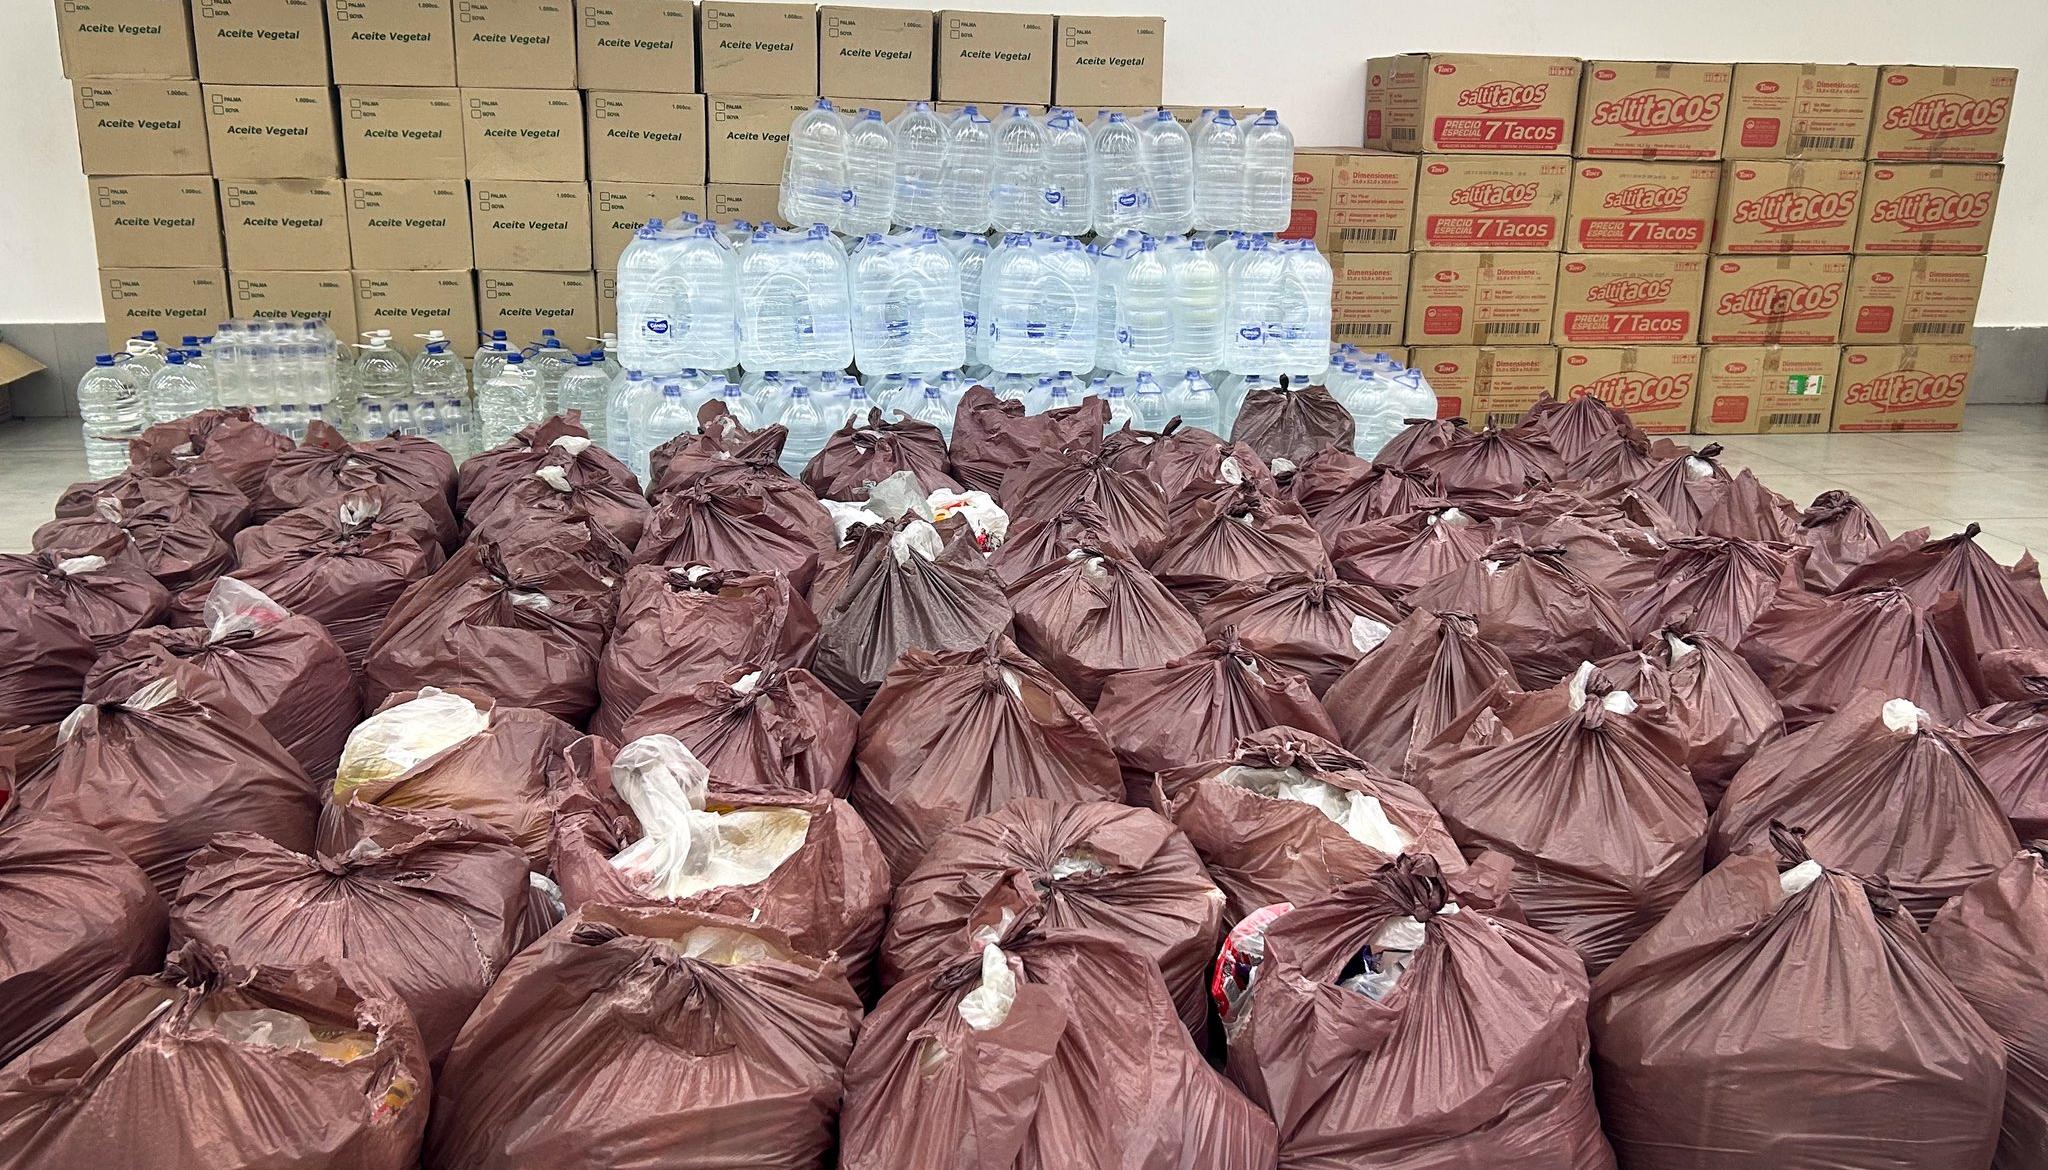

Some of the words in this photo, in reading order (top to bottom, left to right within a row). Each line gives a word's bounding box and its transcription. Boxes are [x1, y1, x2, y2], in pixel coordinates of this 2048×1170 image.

[79, 24, 114, 33] Aceite
[118, 24, 161, 34] Vegetal
[217, 29, 253, 39] Aceite
[257, 30, 300, 40] Vegetal
[351, 32, 387, 41] Aceite
[389, 33, 431, 42] Vegetal
[472, 33, 507, 43] Aceite
[509, 34, 550, 44] Vegetal
[597, 38, 631, 48] Aceite
[634, 39, 673, 49] Vegetal
[720, 40, 752, 49] Aceite
[755, 41, 794, 51] Vegetal
[840, 48, 872, 58] Aceite
[874, 49, 912, 60] Vegetal
[960, 50, 992, 60] Aceite
[994, 51, 1031, 61] Vegetal
[1076, 57, 1107, 66] Aceite
[1109, 57, 1145, 66] Vegetal
[98, 119, 134, 128] Aceite
[137, 120, 181, 129] Vegetal
[1444, 121, 1481, 129] PRECIO
[228, 126, 263, 135] Aceite
[266, 126, 308, 136] Vegetal
[364, 129, 398, 138] Aceite
[402, 129, 442, 139] Vegetal
[484, 129, 517, 137] Aceite
[520, 129, 560, 138] Vegetal
[607, 129, 640, 138] Aceite
[643, 131, 682, 141] Vegetal
[1442, 129, 1481, 137] ESPECIAL
[1485, 121, 1501, 140] 7
[1504, 122, 1556, 140] Tacos
[727, 132, 759, 140] Aceite
[115, 218, 150, 226] Aceite
[154, 218, 195, 227] Vegetal
[244, 218, 278, 226] Aceite
[281, 218, 323, 228] Vegetal
[368, 219, 402, 227] Aceite
[406, 219, 446, 228] Vegetal
[493, 220, 526, 229] Aceite
[529, 221, 568, 230] Vegetal
[612, 221, 643, 230] Aceite
[1437, 219, 1472, 227] PRECIO
[1476, 219, 1493, 237] 7
[1495, 220, 1548, 237] Tacos
[1627, 222, 1644, 240] 7
[1646, 222, 1697, 240] Tacos
[127, 308, 162, 317] Aceite
[165, 309, 207, 318] Vegetal
[253, 309, 287, 319] Aceite
[290, 310, 331, 320] Vegetal
[375, 308, 408, 316] Aceite
[410, 308, 451, 317] Vegetal
[500, 308, 532, 316] Aceite
[535, 308, 574, 317] Vegetal
[1575, 314, 1609, 322] PRECIO
[1614, 314, 1628, 332] 7
[1632, 315, 1682, 331] Tacos
[1572, 322, 1609, 330] ESPECIAL
